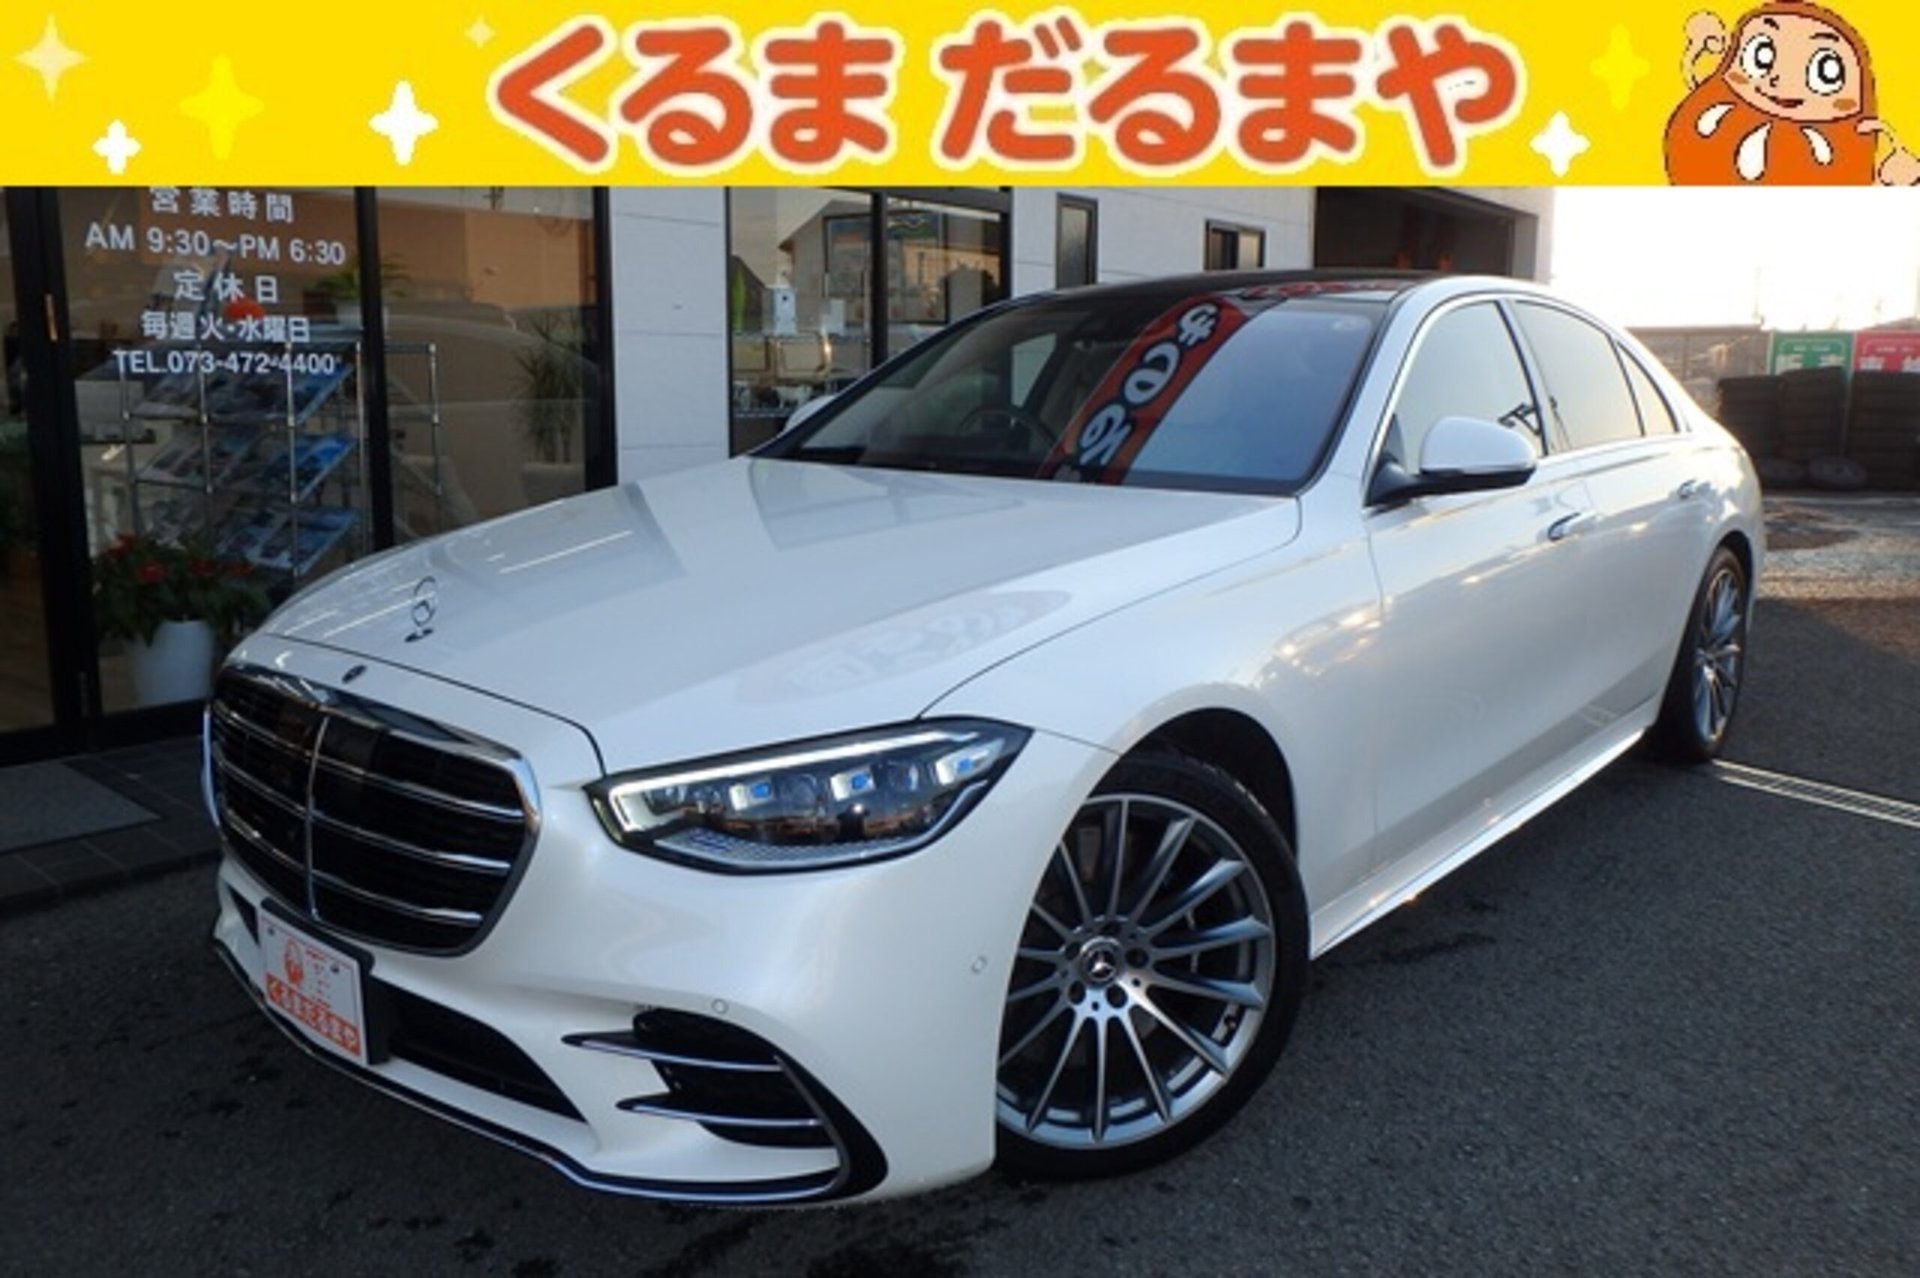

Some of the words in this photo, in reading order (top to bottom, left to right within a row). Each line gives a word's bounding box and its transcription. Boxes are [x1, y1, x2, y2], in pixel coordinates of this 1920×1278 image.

[149, 187, 294, 223] 営業時間
[85, 222, 135, 250] AM
[289, 238, 347, 266] 6:30
[173, 269, 279, 304] 定休日
[112, 349, 336, 375] TEL.073-472-4400
